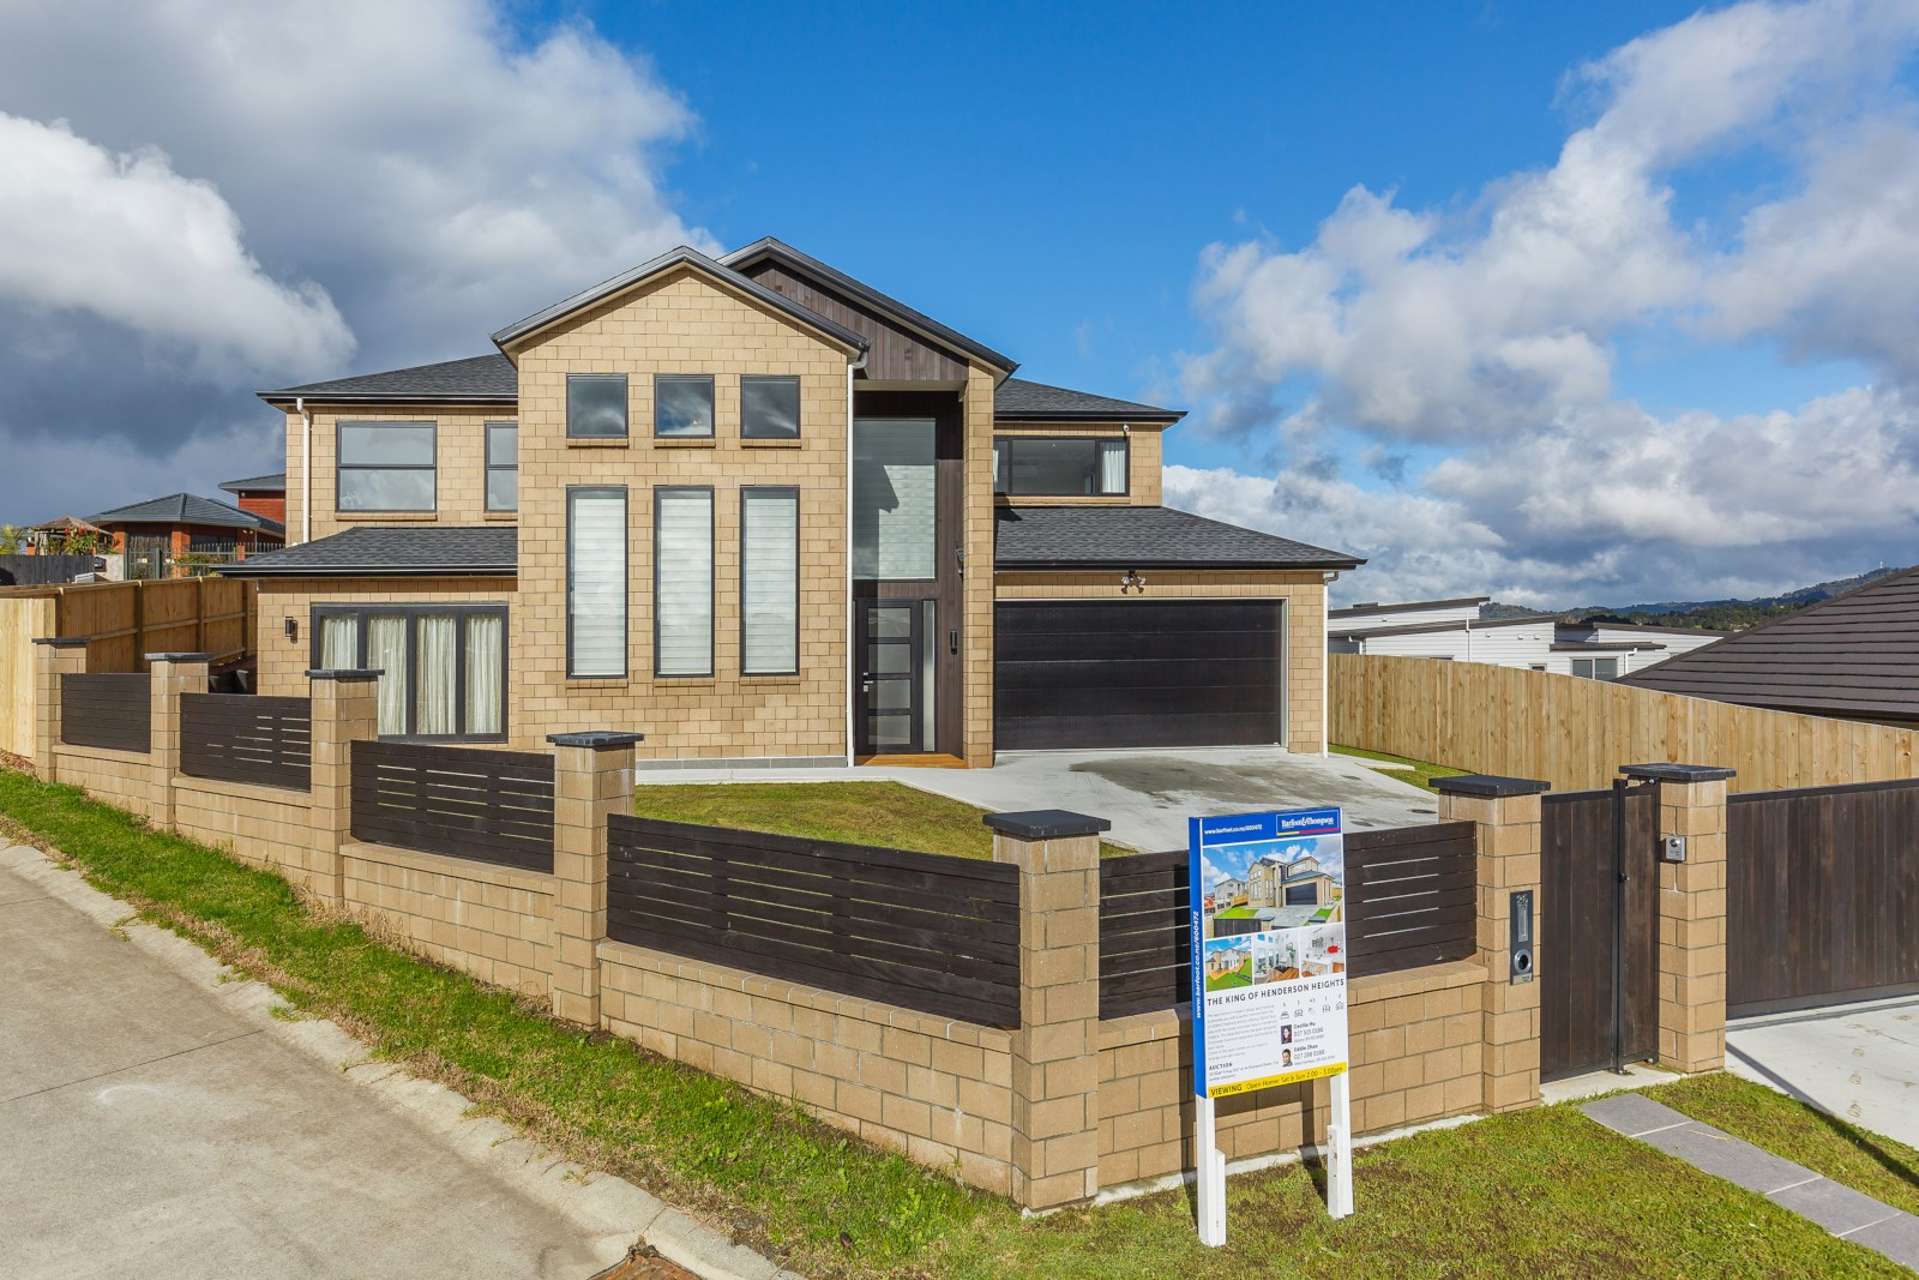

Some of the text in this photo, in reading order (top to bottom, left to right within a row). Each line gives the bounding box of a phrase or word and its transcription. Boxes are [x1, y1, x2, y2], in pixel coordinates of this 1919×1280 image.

[1207, 996, 1223, 1006] THE
[1226, 994, 1246, 1003] KING
[1248, 991, 1259, 1001] OF
[1261, 983, 1310, 998] HENDERSON
[1312, 978, 1345, 990] HEIGHTS
[1209, 1062, 1233, 1071] AUCTION
[1210, 1083, 1243, 1097] VIEWING
[1246, 1081, 1261, 1091] Open
